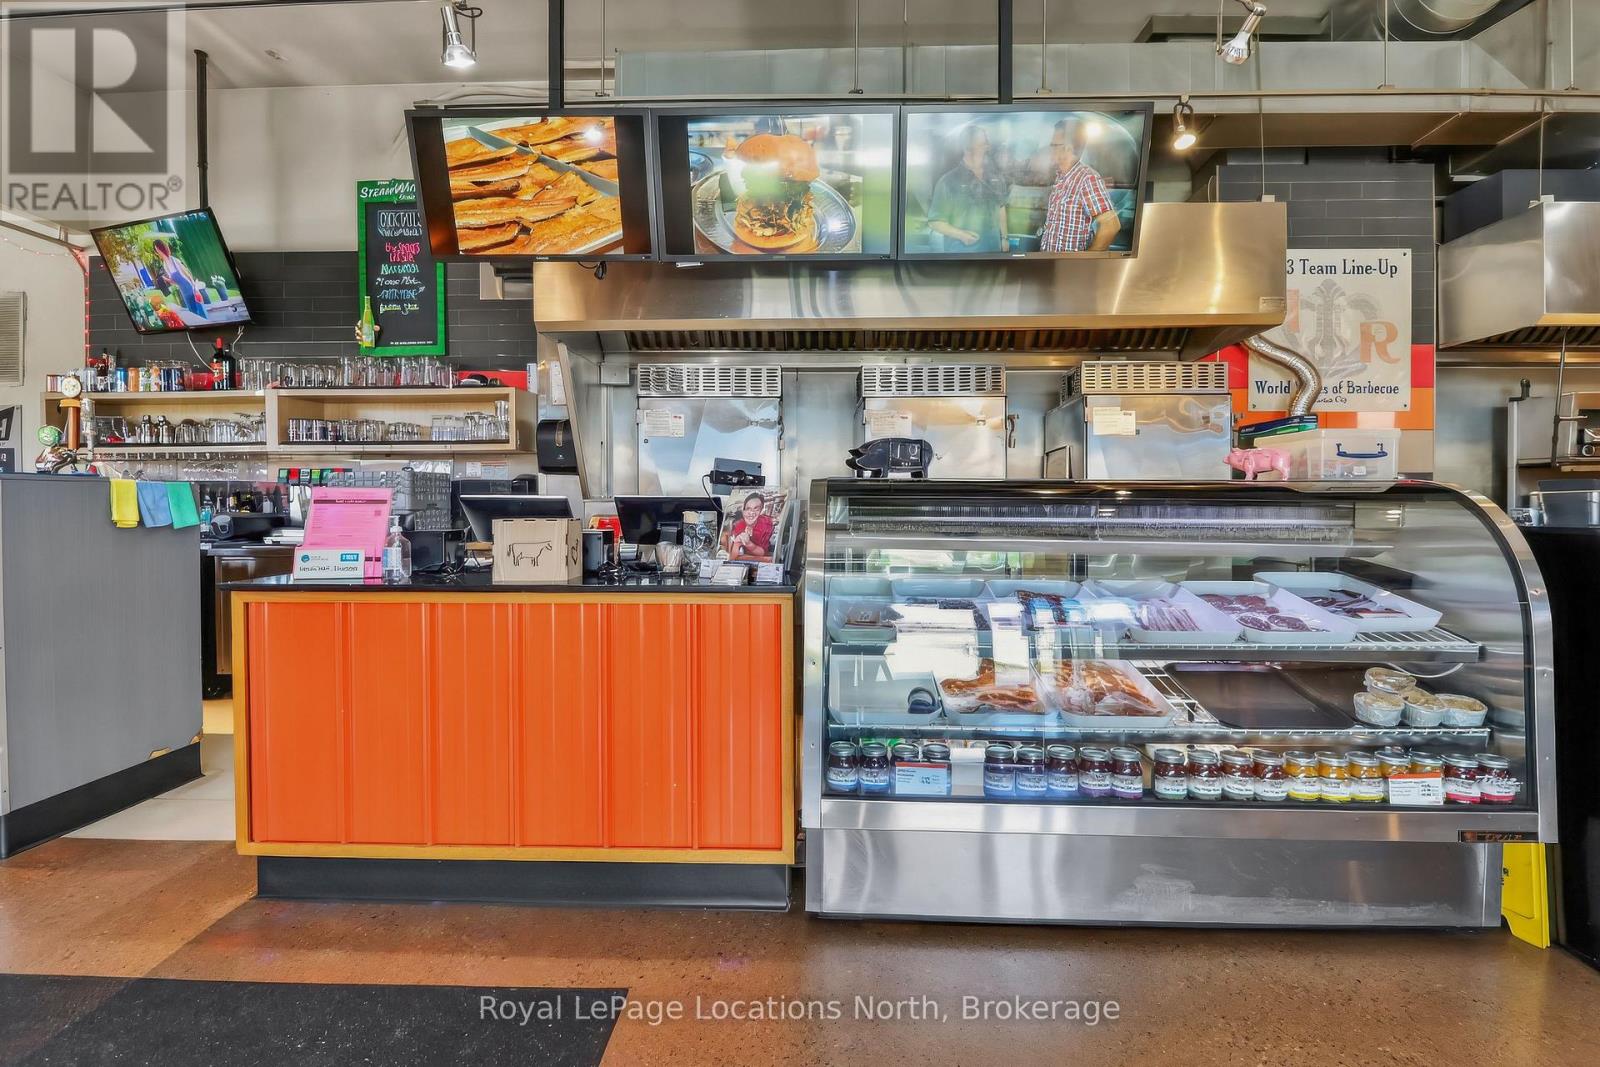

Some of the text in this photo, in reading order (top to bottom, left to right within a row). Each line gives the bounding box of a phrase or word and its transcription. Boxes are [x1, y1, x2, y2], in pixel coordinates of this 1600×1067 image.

[1299, 258, 1337, 275] Team
[1342, 258, 1398, 278] Line-Up
[1255, 380, 1291, 394] World
[1332, 380, 1344, 394] of
[1347, 380, 1400, 394] Barbecue
